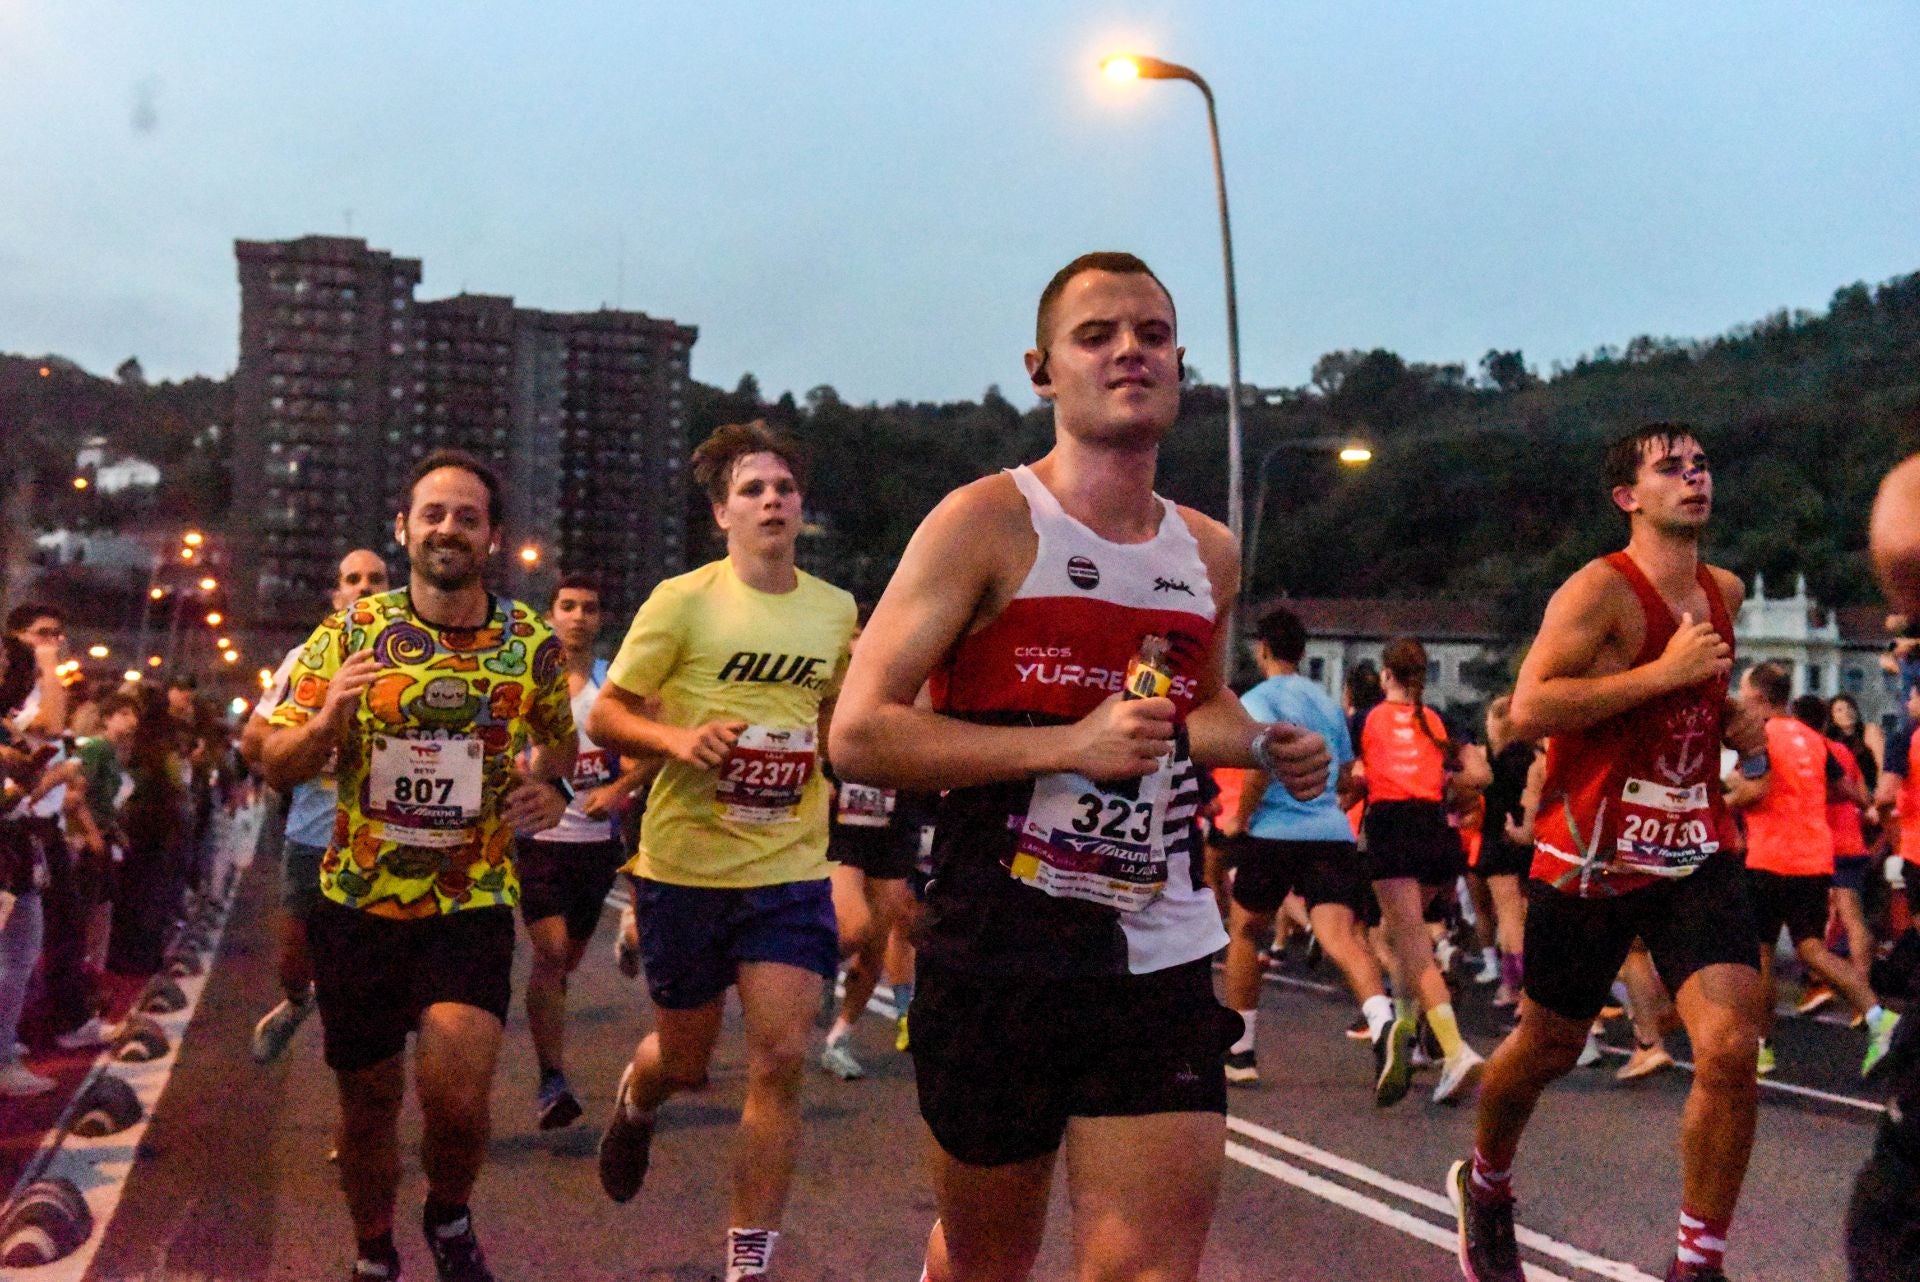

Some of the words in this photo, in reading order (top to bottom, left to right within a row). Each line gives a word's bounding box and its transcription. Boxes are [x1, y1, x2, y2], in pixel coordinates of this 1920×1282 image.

[1014, 647, 1072, 657] CICLOS
[727, 758, 807, 787] 22371
[395, 776, 454, 805] 807
[1072, 792, 1152, 842] 323
[1623, 814, 1708, 848] 20130
